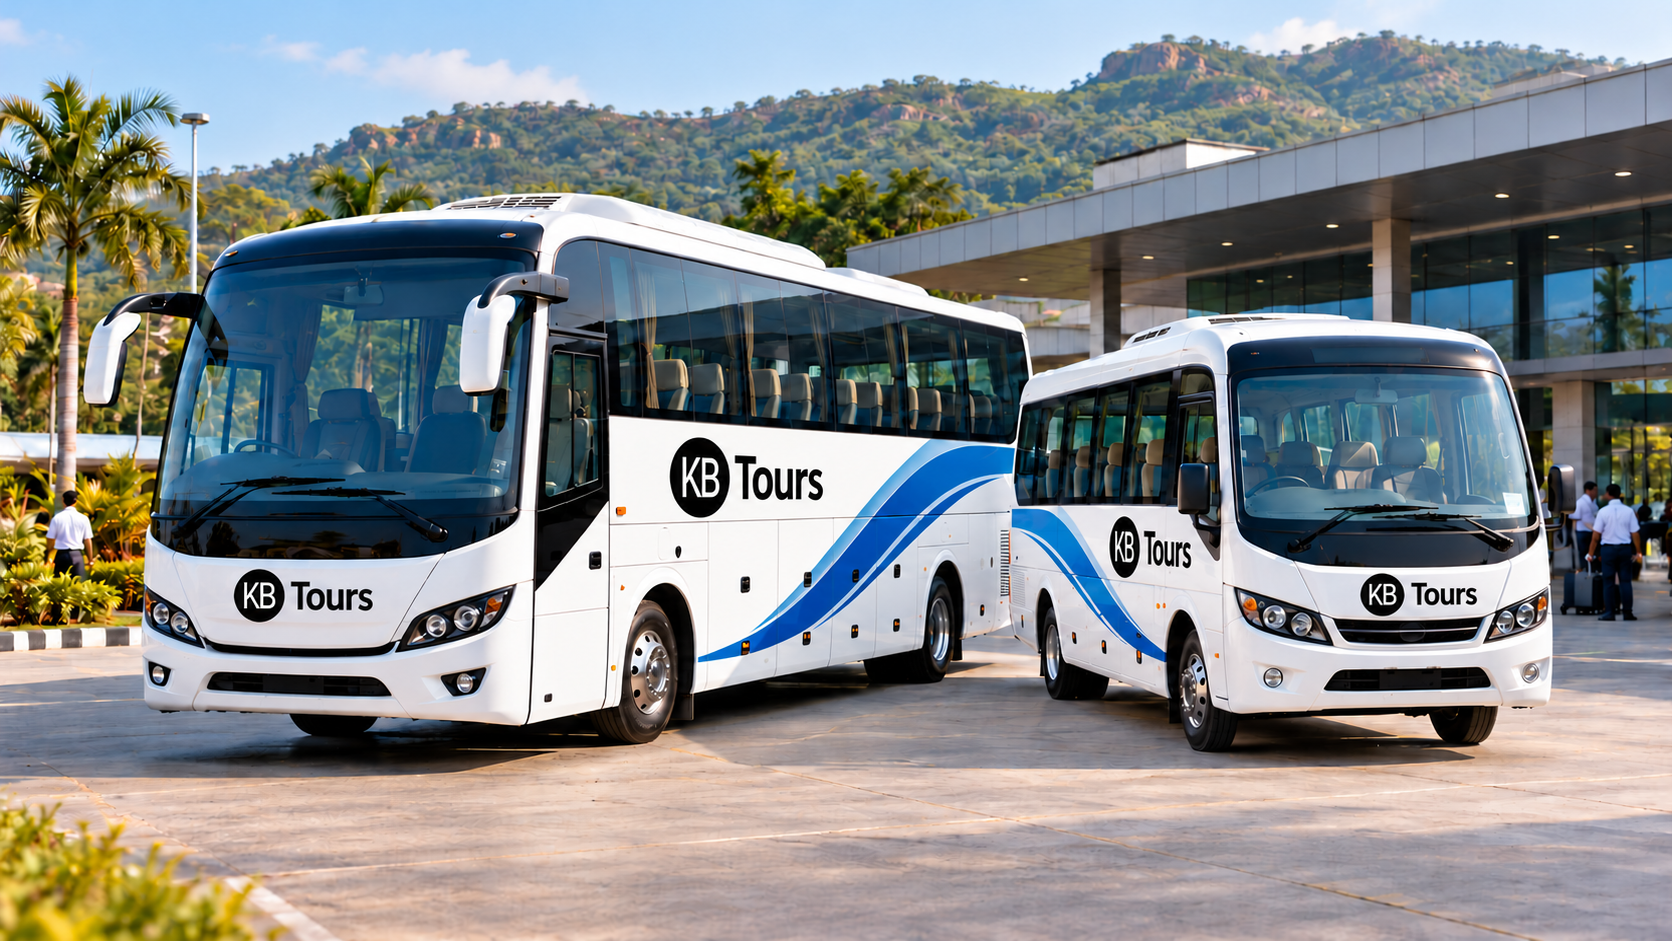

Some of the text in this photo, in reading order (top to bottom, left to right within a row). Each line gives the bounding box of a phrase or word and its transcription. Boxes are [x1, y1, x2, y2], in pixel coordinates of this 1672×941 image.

[683, 455, 824, 501] KB Tours
[1115, 530, 1192, 569] KB Tours
[243, 581, 374, 612] KB Tours
[1368, 582, 1478, 606] KB Tours
